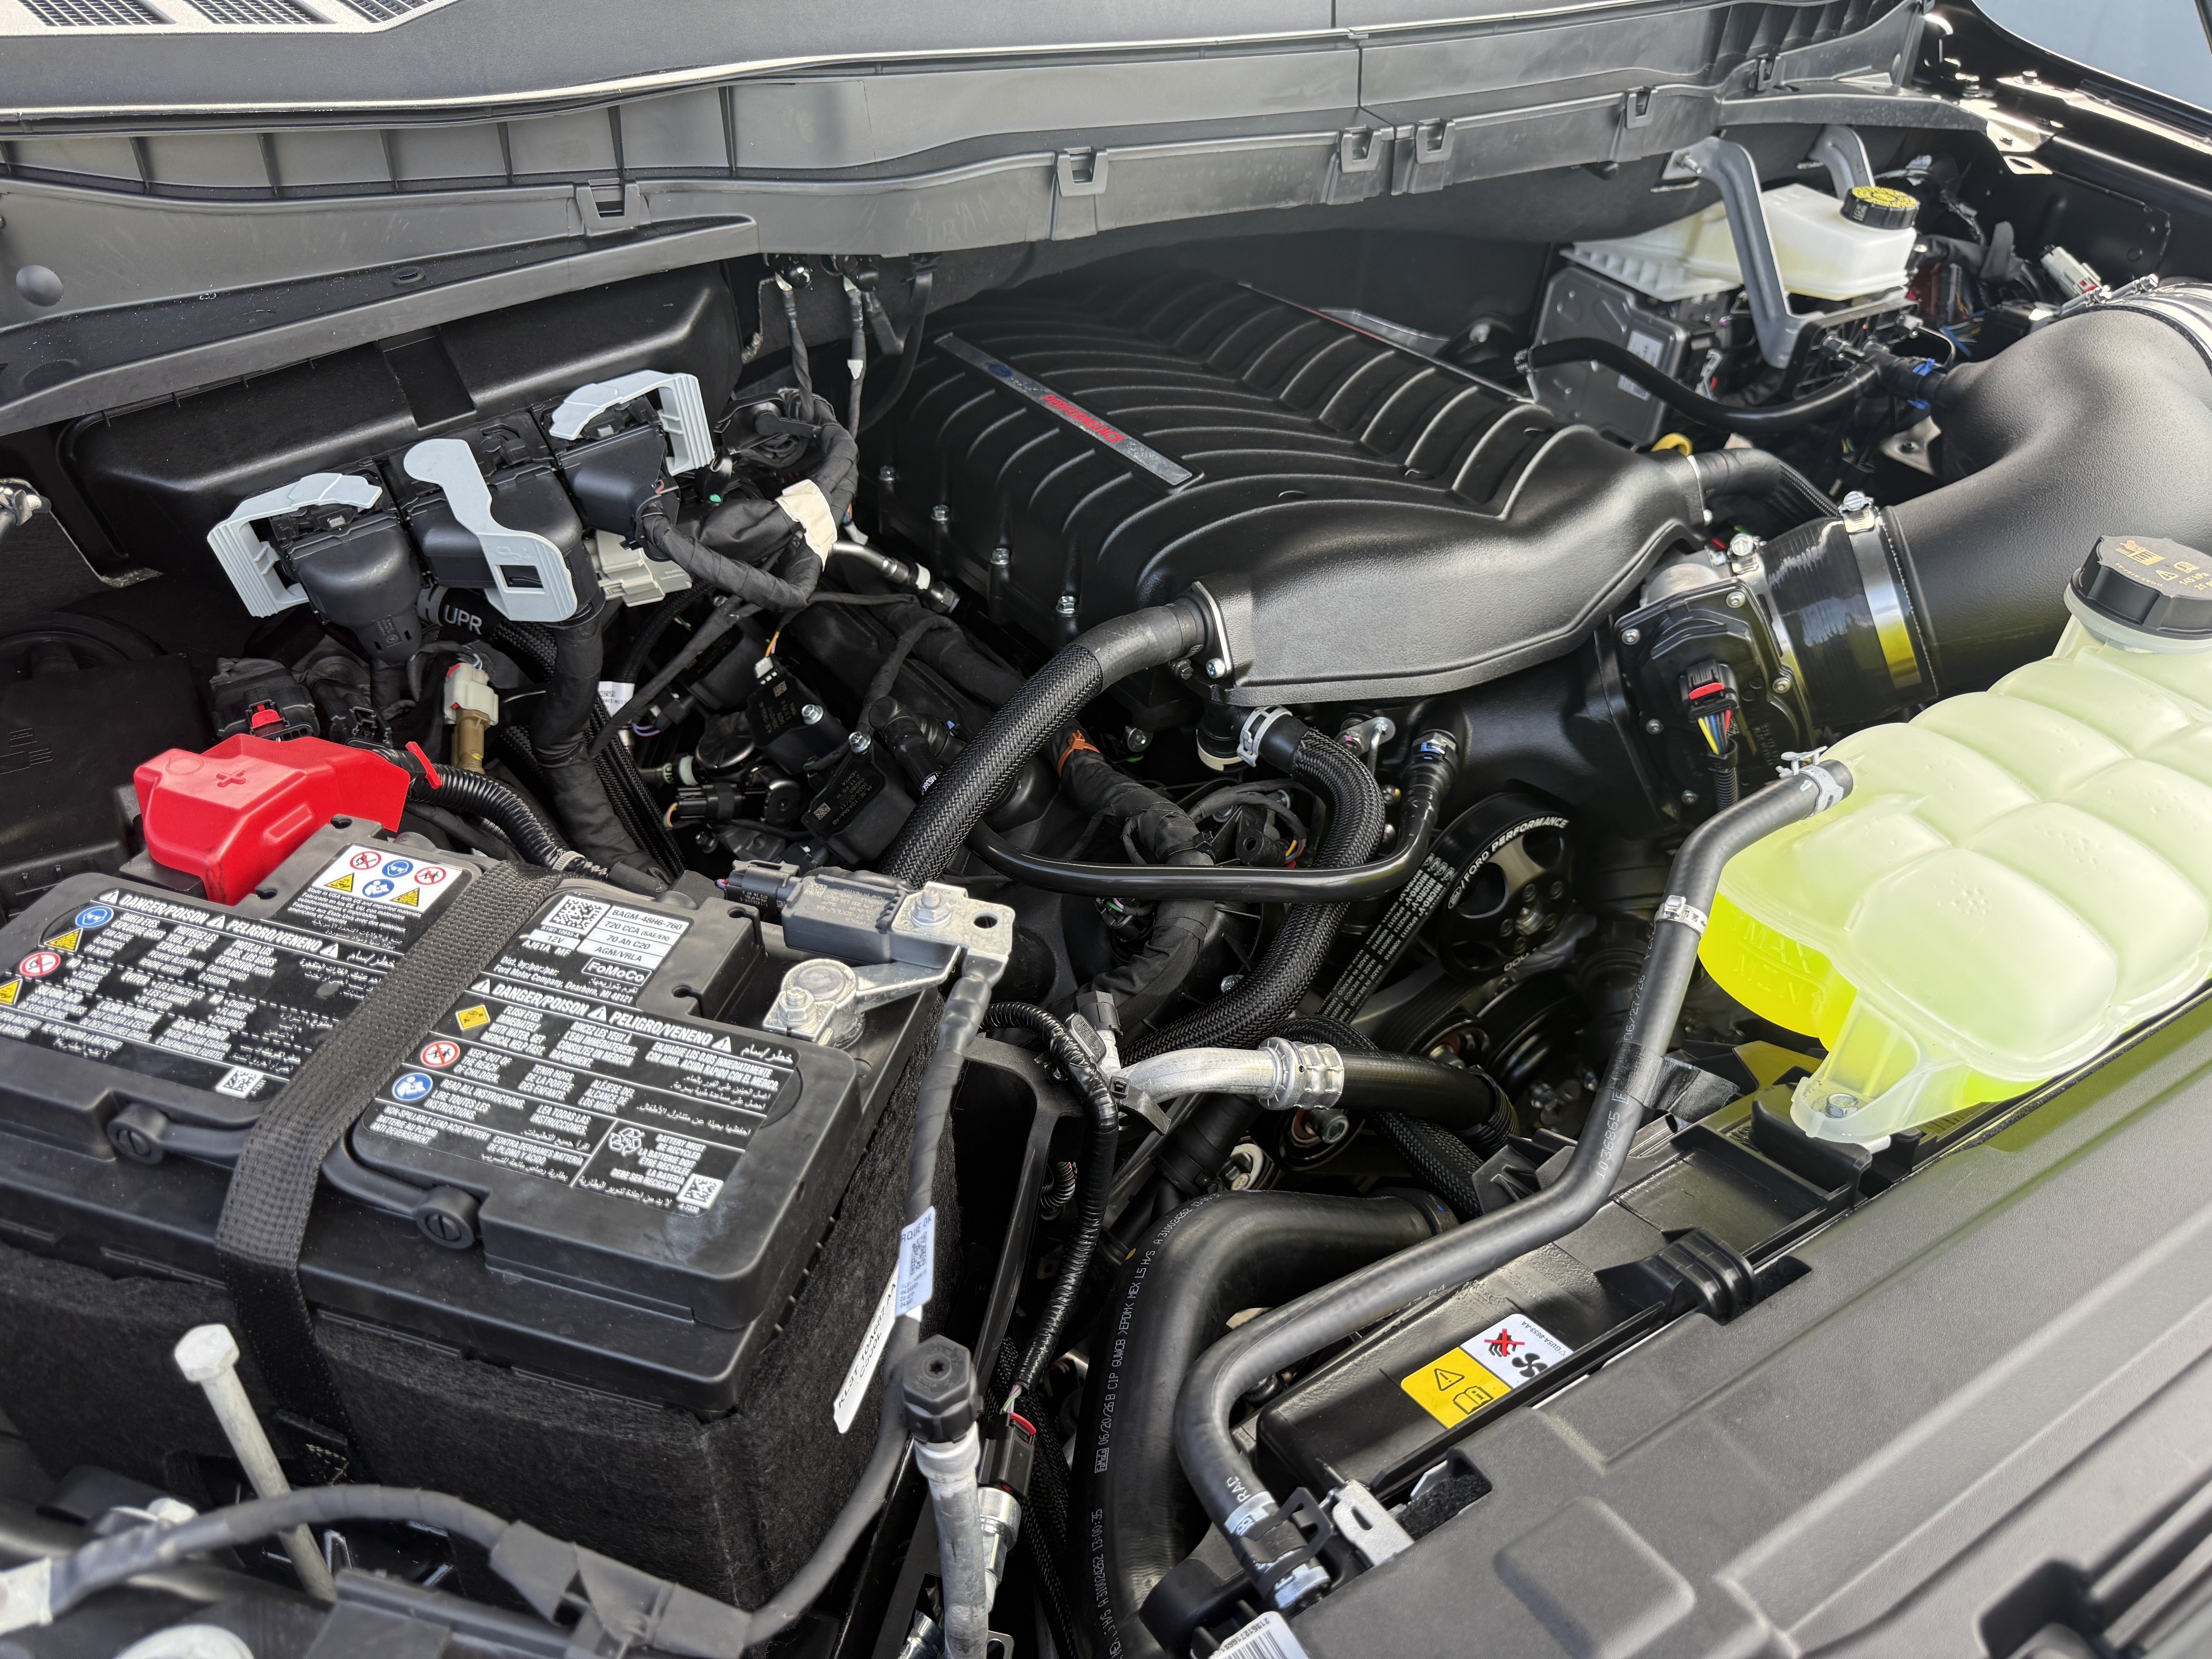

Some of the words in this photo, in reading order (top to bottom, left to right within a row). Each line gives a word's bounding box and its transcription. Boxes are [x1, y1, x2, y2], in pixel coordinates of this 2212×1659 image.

[1040, 394, 1127, 444] PERFORMANCE
[2179, 577, 2195, 585] 145
[443, 604, 483, 634] UPR
[1463, 851, 1490, 882] FORD
[1491, 816, 1570, 852] PERFORMANCE
[1417, 881, 1443, 914] MICRO-V
[118, 895, 210, 924] DANGER/POISON
[371, 903, 397, 912] imported
[396, 908, 423, 917] materials
[611, 910, 682, 930] BAGM-48H6-760
[1399, 915, 1418, 938] 6PK2313
[111, 921, 147, 934] EXPLOSIVE
[144, 929, 166, 939] GASES
[225, 921, 325, 951] PELIGRO/VENENO
[541, 926, 580, 938] R1MT-10655-A
[546, 935, 564, 943] 12V
[622, 925, 641, 933] CCA
[641, 931, 670, 941] (SAE/EN)
[93, 937, 125, 949] BLINDNESS
[157, 942, 192, 955] EXPLOSIFS
[232, 940, 262, 952] PROTEJA
[259, 946, 274, 955] LOS
[522, 940, 551, 951] AJ61A
[554, 948, 571, 956] MF
[1382, 938, 1401, 961] K060910
[1744, 922, 1811, 973] MAX
[500, 957, 518, 965] Dist.
[595, 946, 643, 961] AGM/VRLA
[67, 959, 81, 967] NO
[84, 964, 111, 975] SPARKS
[587, 962, 646, 982] FoMoCo
[1368, 964, 1382, 980] MADE
[67, 979, 98, 991] SMOKING
[76, 971, 102, 982] FLAMES
[493, 965, 511, 974] Ford
[510, 969, 532, 978] Motor
[530, 974, 565, 988] Company,
[564, 982, 600, 996] Dearborn,
[148, 999, 172, 1009] FUMER
[209, 994, 223, 1003] NO
[491, 984, 589, 1016] DANGER/POISON
[1349, 985, 1367, 1006] MEXICO
[220, 1008, 247, 1019] FLAMAS
[227, 1000, 256, 1012] CHISPAS
[503, 1006, 526, 1017] FLUSH
[523, 1011, 543, 1022] EYES
[211, 1015, 246, 1029] CIGARROS
[496, 1015, 541, 1031] IMMEDIATELY
[608, 1012, 714, 1047] PELIGRO/VENENO
[164, 1029, 184, 1039] PUEDE
[182, 1034, 206, 1044] CAUSAR
[204, 1039, 232, 1051] CEGUERA
[480, 1032, 512, 1046] MEDICAL
[508, 1039, 529, 1050] HELP
[526, 1043, 547, 1055] FAST.
[460, 1056, 476, 1066] THE
[474, 1060, 500, 1072] REACH
[466, 1048, 486, 1059] KEEP
[484, 1053, 501, 1062] OUT
[499, 1056, 513, 1065] OF
[548, 1049, 595, 1067] RAPIDEMENT.
[652, 1042, 687, 1056] ENJUAGUE
[685, 1049, 700, 1060] LOS
[698, 1053, 717, 1064] OJOS
[715, 1057, 773, 1077] INMEDIATAMENTE
[453, 1065, 465, 1073] OF
[463, 1067, 501, 1082] CHILDREN.
[525, 1073, 537, 1082] DE
[535, 1075, 548, 1084] LA
[532, 1065, 554, 1076] TENIR
[553, 1070, 575, 1081] HORS
[440, 1079, 461, 1091] READ
[459, 1084, 476, 1094] ALL
[473, 1088, 528, 1108] INSTRUCTIONS.
[519, 1081, 534, 1091] DES
[532, 1085, 568, 1099] ENFANTS.
[423, 1099, 479, 1119] INSTRUCTIONS.
[431, 1091, 450, 1101] LIRE
[448, 1095, 476, 1108] TOUTES
[475, 1102, 491, 1111] LES
[383, 1106, 432, 1124] NON-SPILLABLE
[430, 1118, 448, 1128] LEAD
[447, 1123, 464, 1132] ACID
[462, 1127, 491, 1140] BATTERY
[536, 1104, 553, 1115] LEA
[551, 1108, 577, 1121] TODAS
[575, 1115, 591, 1125] LAS
[376, 1115, 407, 1128] BATTERIE
[414, 1125, 438, 1137] PLOMB
[529, 1113, 589, 1135] INSTRUCCIONES.
[656, 1134, 685, 1147] BATTERY
[686, 1142, 706, 1152] MUST
[648, 1151, 679, 1163] BATTERIE
[679, 1158, 696, 1168] DOIT
[667, 1146, 701, 1159] RECYCLED
[611, 1168, 630, 1178] DEBE
[629, 1173, 644, 1182] SER
[643, 1177, 680, 1192] RECICLADA
[901, 1222, 921, 1244] RQUE
[923, 1212, 931, 1228] OK
[1127, 1281, 1141, 1299] MEX
[836, 1364, 861, 1408] KL3T
[860, 1305, 888, 1362] 10A687
[884, 1283, 897, 1305] AA
[1226, 1476, 1250, 1503] RAD
